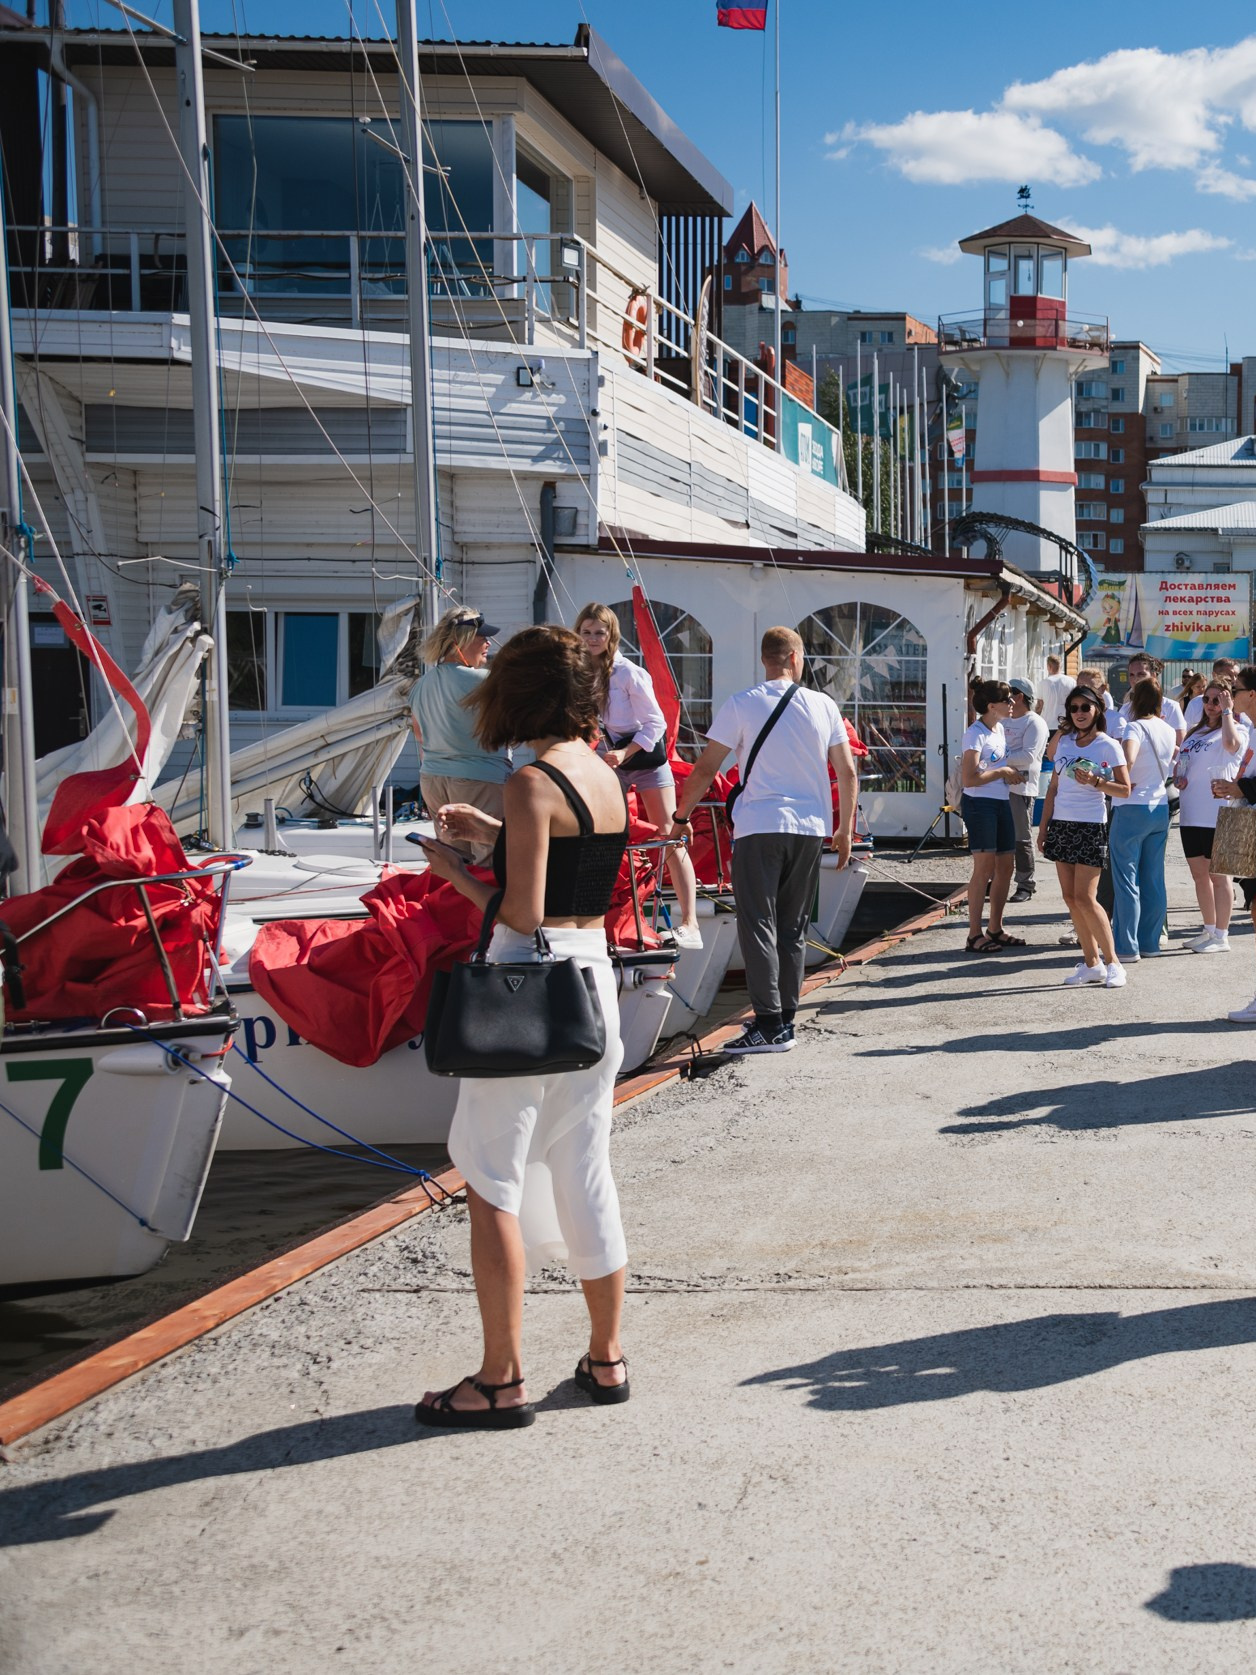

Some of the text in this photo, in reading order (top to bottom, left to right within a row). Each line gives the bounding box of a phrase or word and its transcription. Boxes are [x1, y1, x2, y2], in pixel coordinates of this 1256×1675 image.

[1158, 581, 1237, 592] Доставляем
[1163, 595, 1231, 605] лекарства
[1196, 609, 1236, 617] парусах
[1164, 622, 1231, 632] zhivika.ru
[5, 1057, 94, 1171] 7
